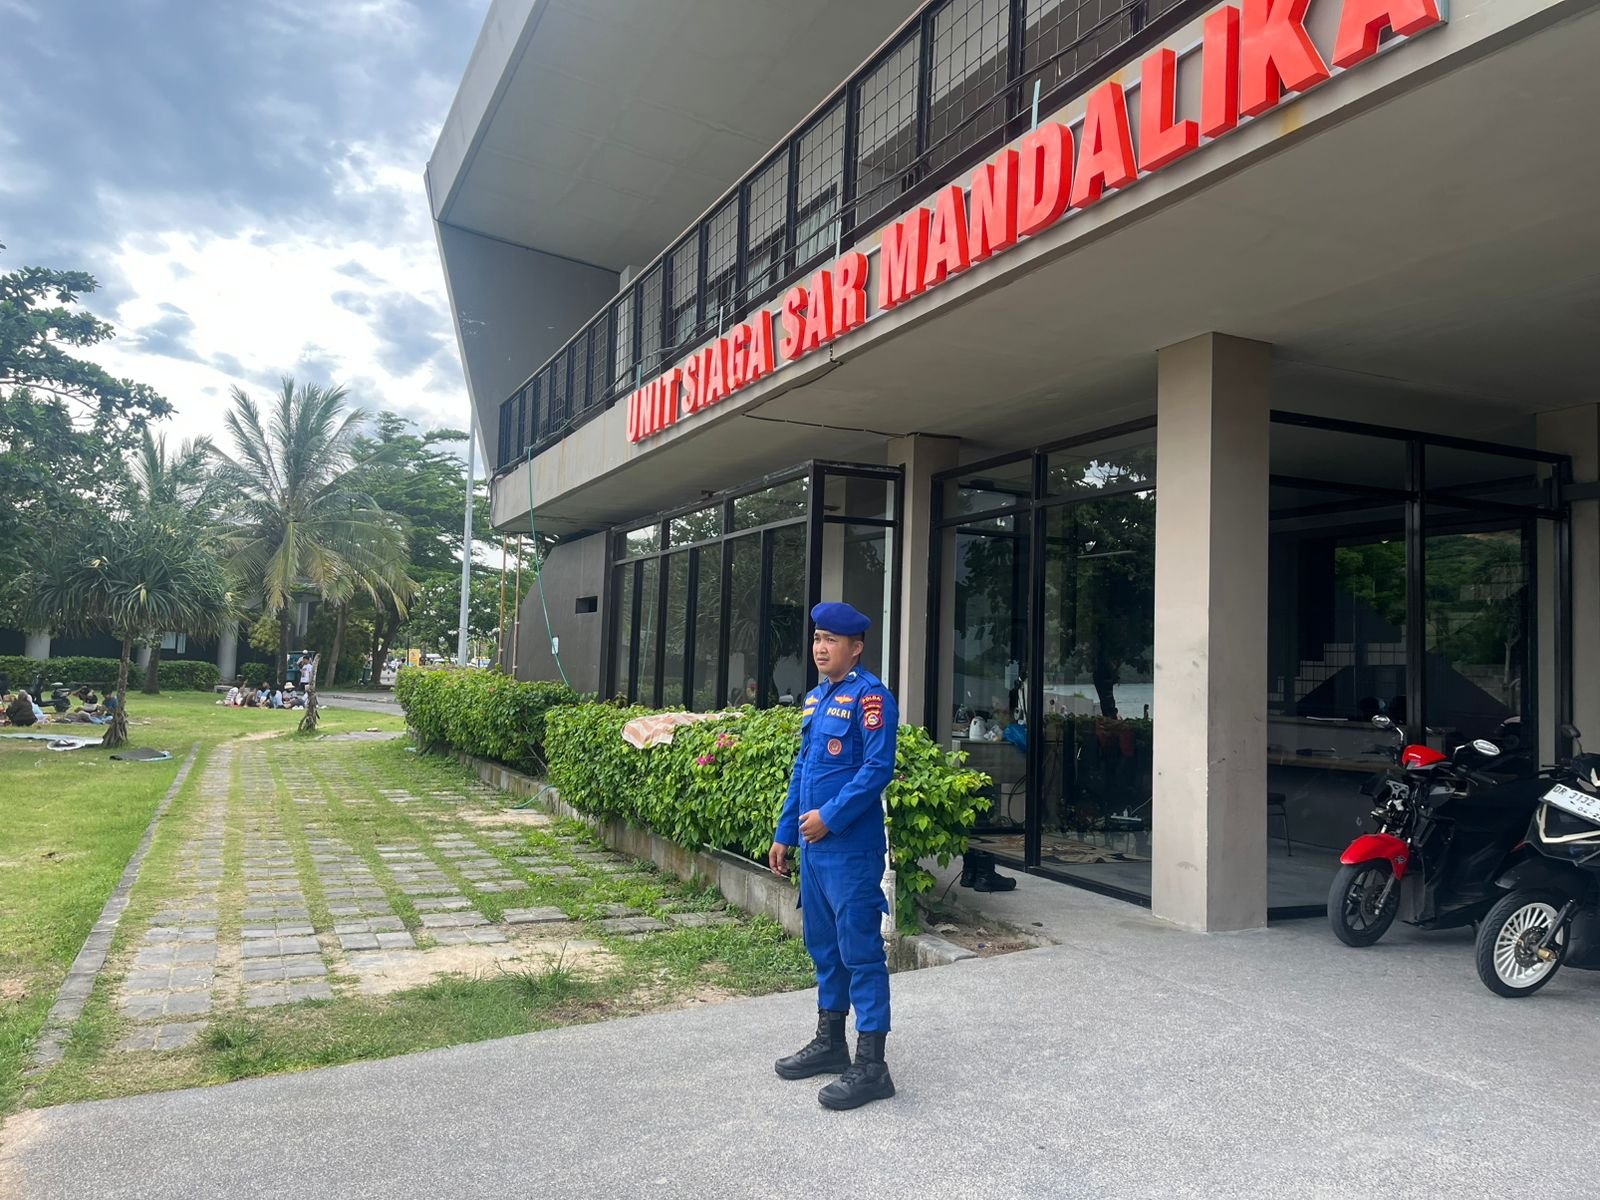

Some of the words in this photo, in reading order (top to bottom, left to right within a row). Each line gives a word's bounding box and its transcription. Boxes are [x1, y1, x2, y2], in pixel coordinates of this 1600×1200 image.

[626, 368, 682, 444] UNIT
[681, 309, 775, 415] SIAGA
[778, 251, 869, 361] SAR
[826, 707, 851, 720] POLRI
